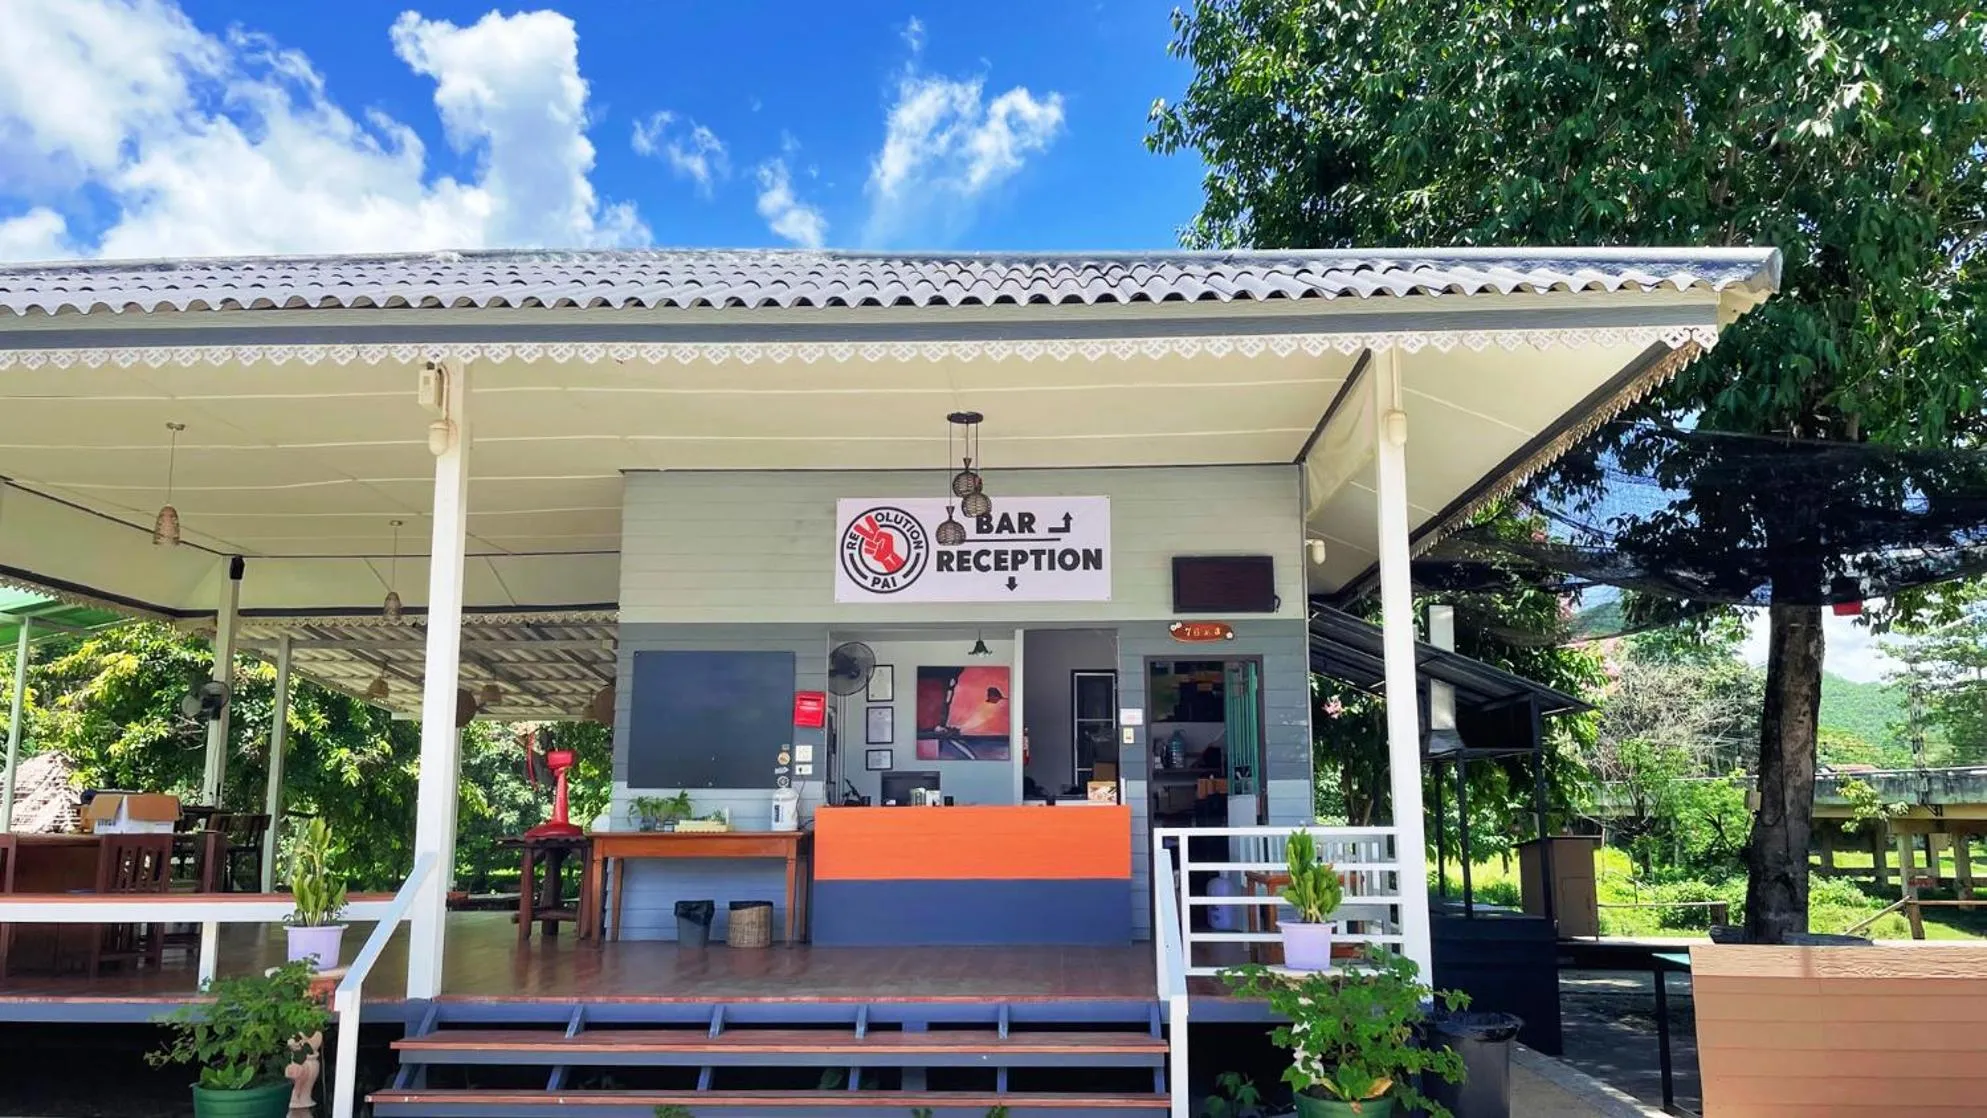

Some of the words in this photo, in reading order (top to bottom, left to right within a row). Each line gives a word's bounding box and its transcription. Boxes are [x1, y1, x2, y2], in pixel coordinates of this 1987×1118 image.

[975, 512, 1036, 534] BAR
[936, 548, 1103, 572] RECEPTION
[871, 576, 897, 589] PAI
